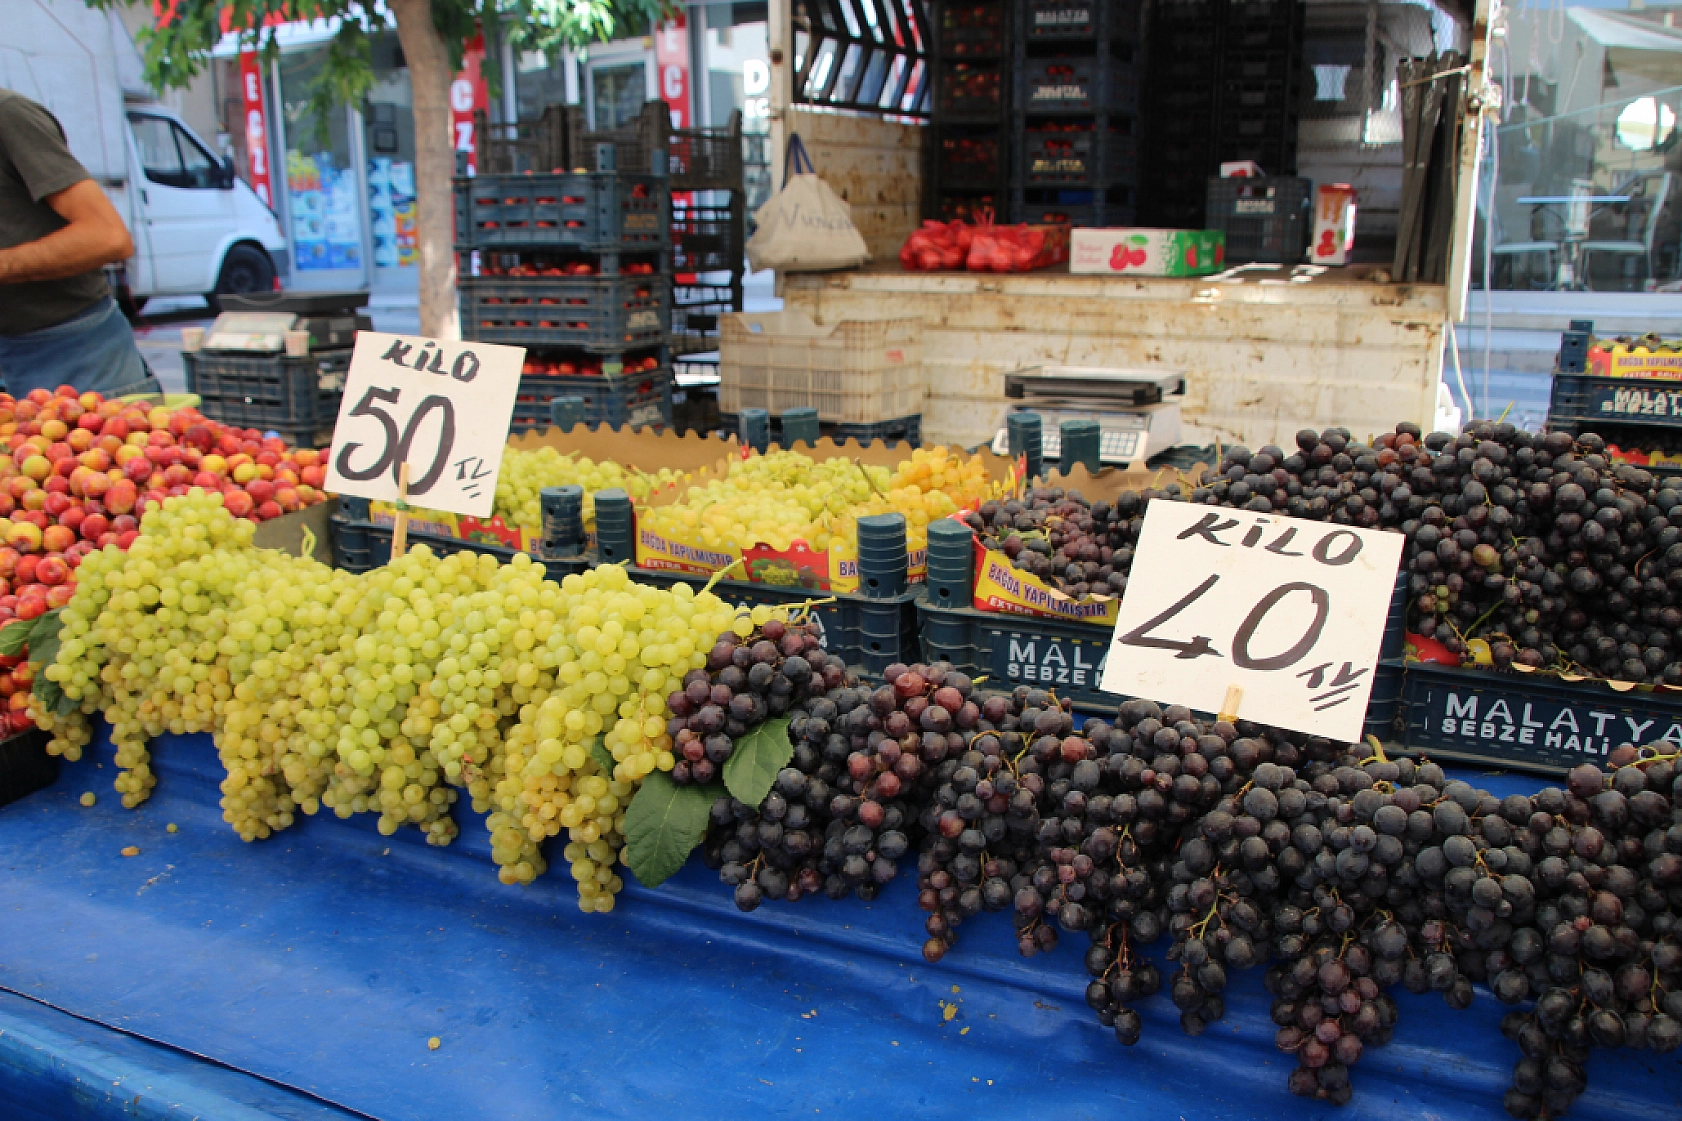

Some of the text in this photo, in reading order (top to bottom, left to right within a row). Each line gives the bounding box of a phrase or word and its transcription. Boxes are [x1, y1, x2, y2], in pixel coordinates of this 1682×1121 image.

[336, 386, 493, 495] 50 TL
[1118, 573, 1330, 671] 40
[1007, 662, 1086, 686] SEBZE
[1441, 718, 1536, 745] SEBZE
[1446, 693, 1682, 743] MALATYA
